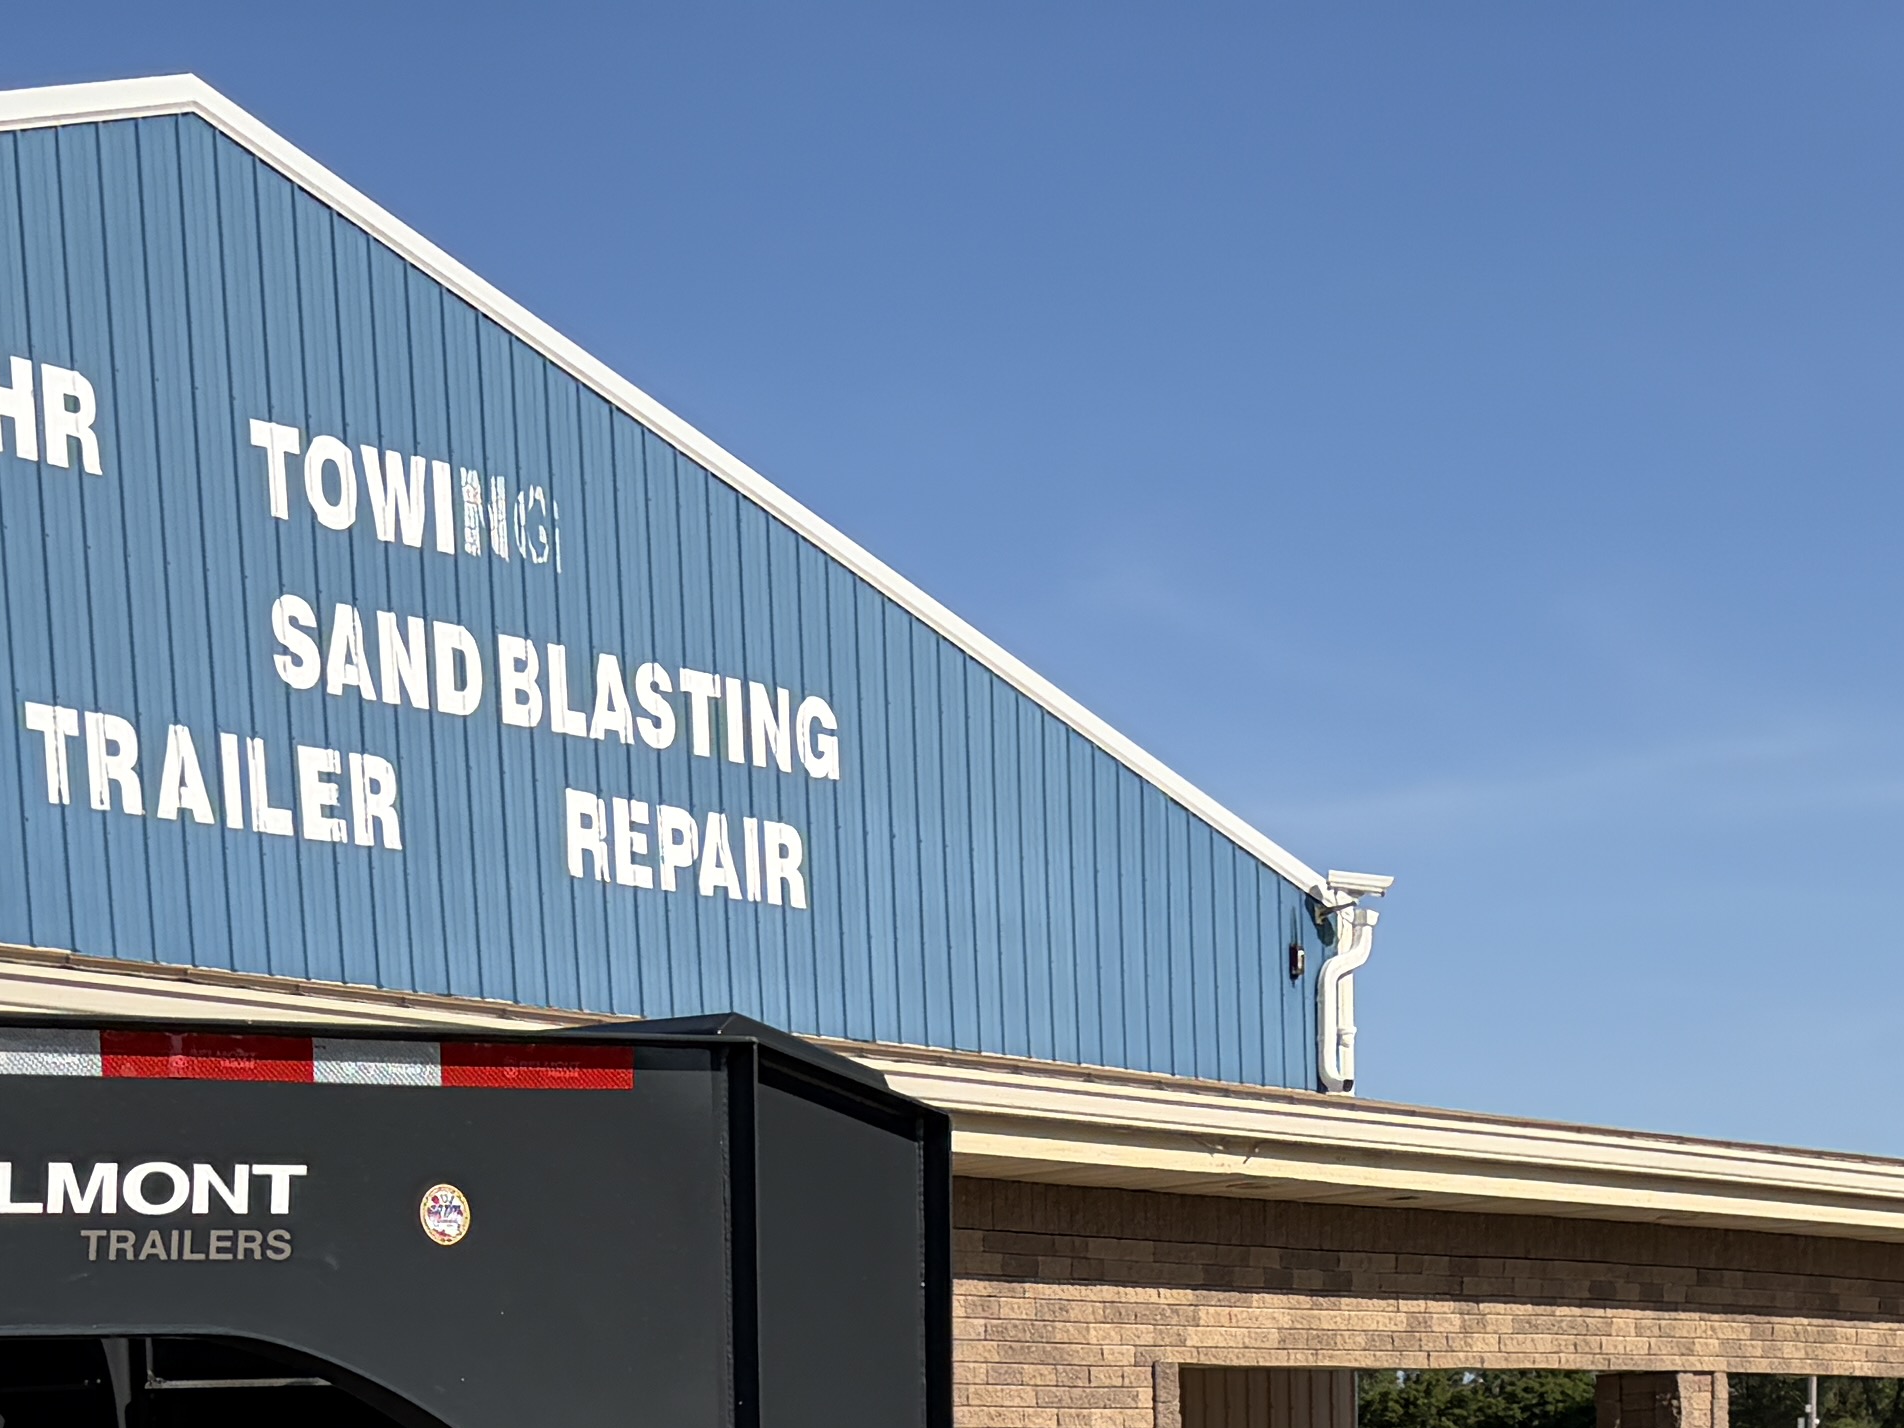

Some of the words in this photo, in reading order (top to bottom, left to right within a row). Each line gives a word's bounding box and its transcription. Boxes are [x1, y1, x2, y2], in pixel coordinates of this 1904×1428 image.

[25, 701, 403, 850] TRAILER
[565, 788, 808, 909] REPAIR
[81, 1229, 293, 1261] TRAILERS
